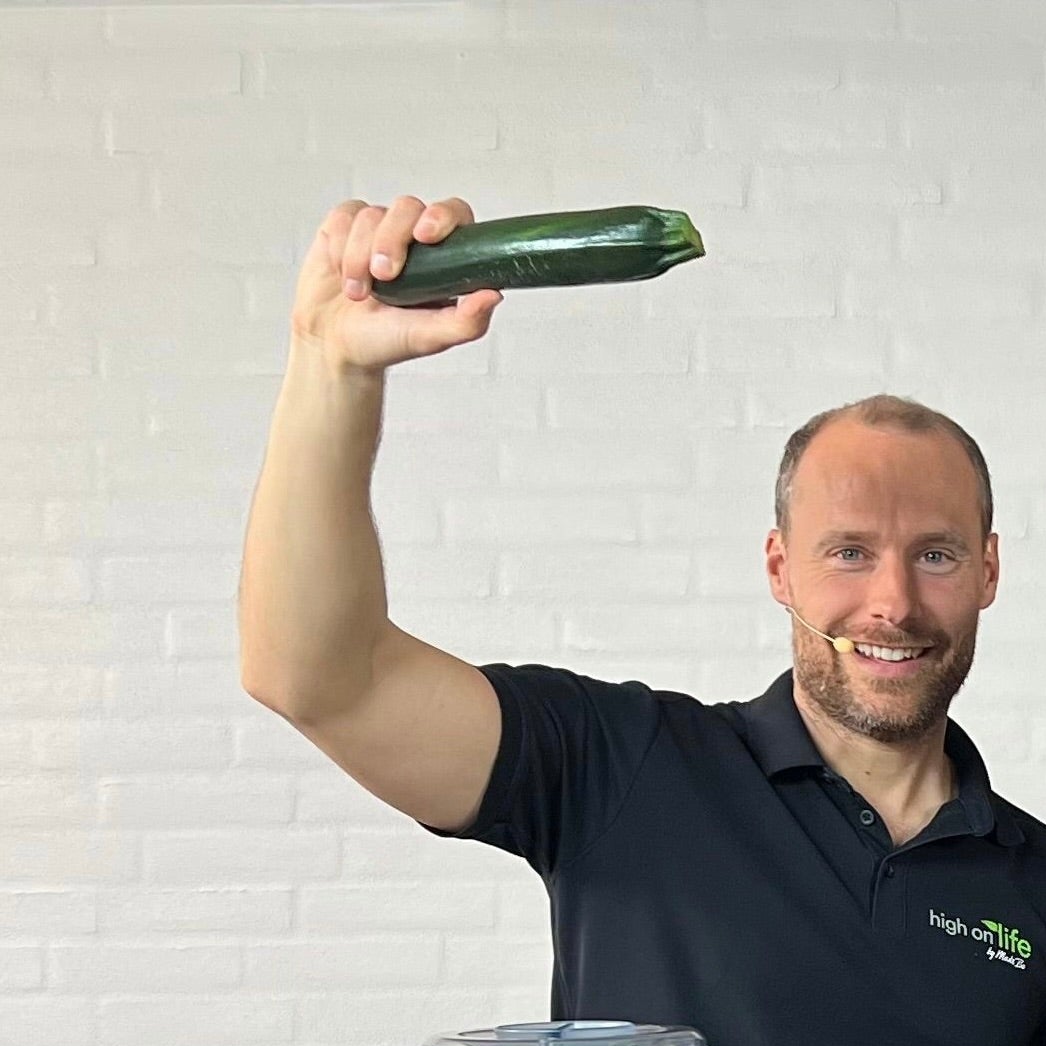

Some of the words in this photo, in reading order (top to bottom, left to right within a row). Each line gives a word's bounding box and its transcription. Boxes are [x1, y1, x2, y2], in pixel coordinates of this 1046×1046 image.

[929, 908, 968, 936] high
[971, 927, 994, 945] on
[997, 922, 1032, 958] life
